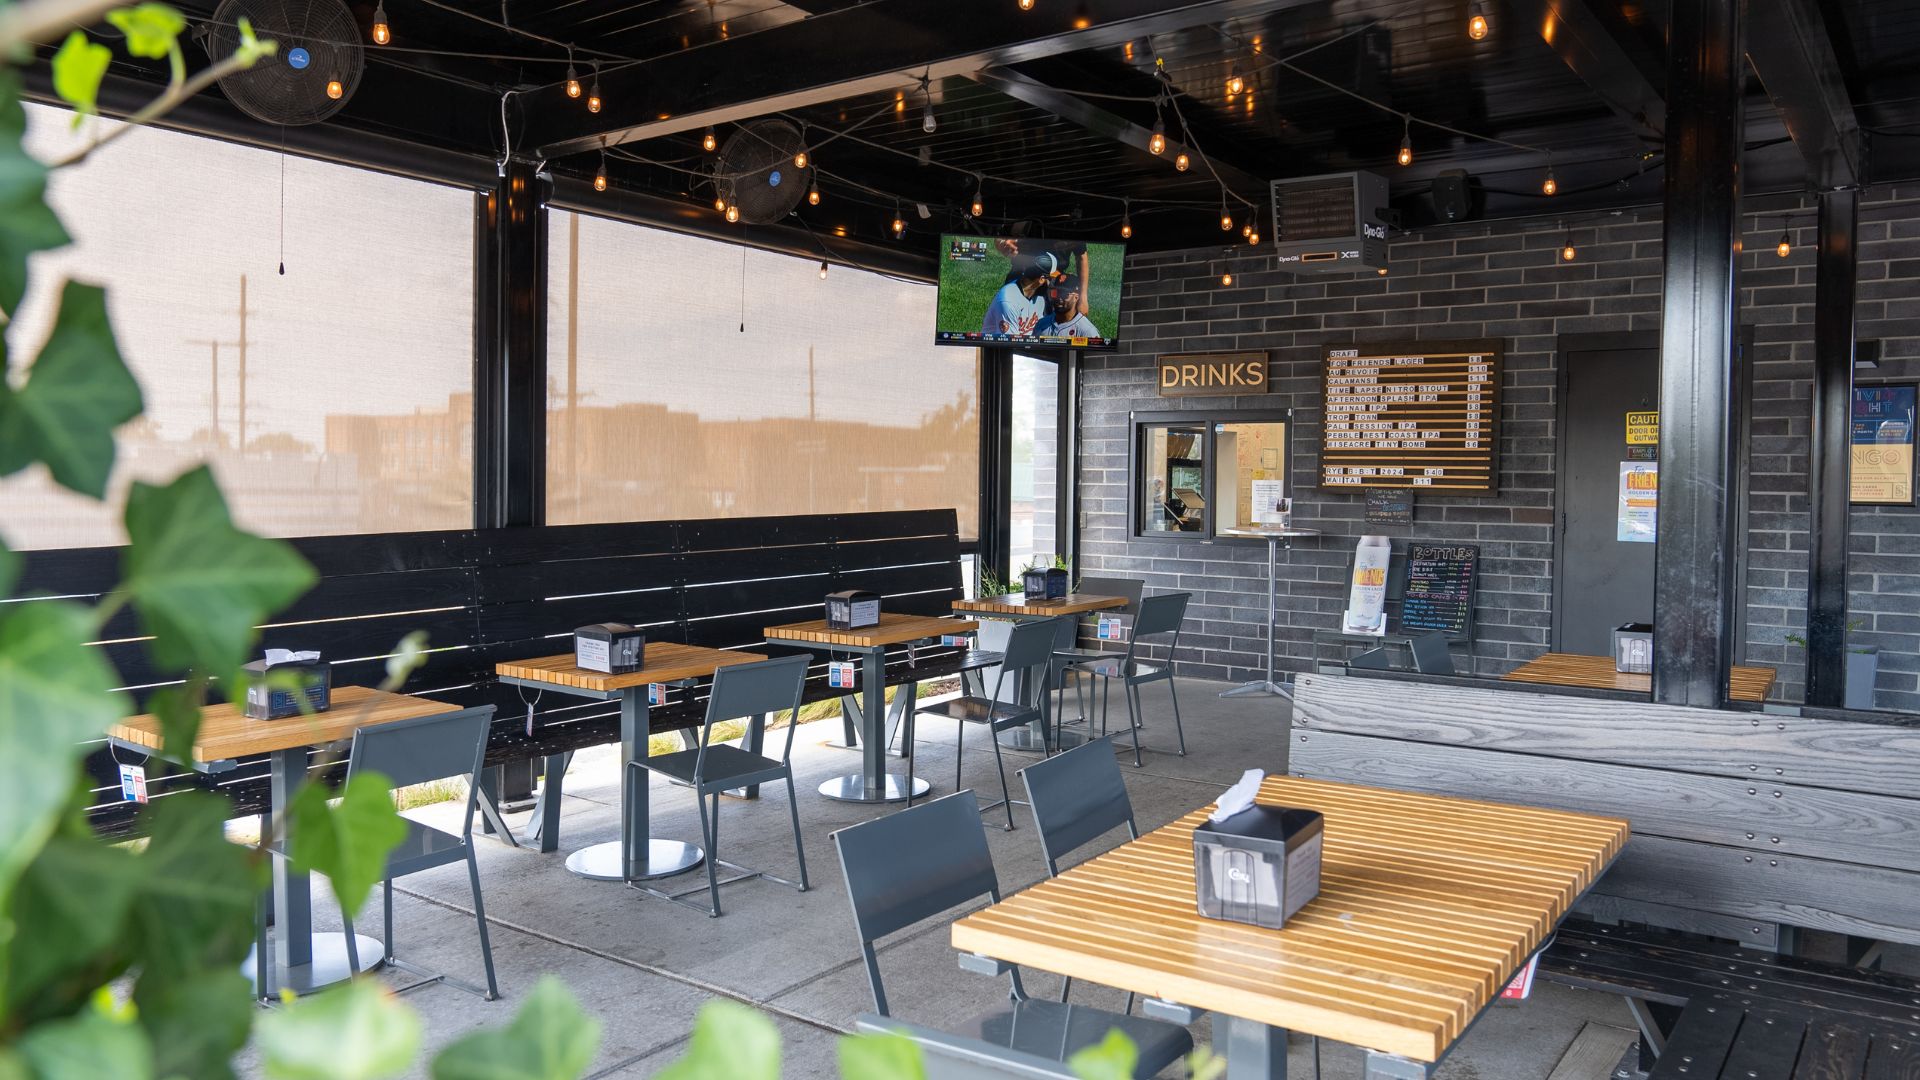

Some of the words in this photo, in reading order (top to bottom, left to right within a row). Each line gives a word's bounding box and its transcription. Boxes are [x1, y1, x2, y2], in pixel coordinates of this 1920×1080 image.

[1330, 350, 1358, 358] DRAFT
[1352, 359, 1390, 367] FRIENDS
[1395, 358, 1424, 366] LAGER
[1161, 361, 1264, 387] DRINKS
[1629, 427, 1648, 435] DOOR
[1413, 546, 1475, 561] BOTTLES
